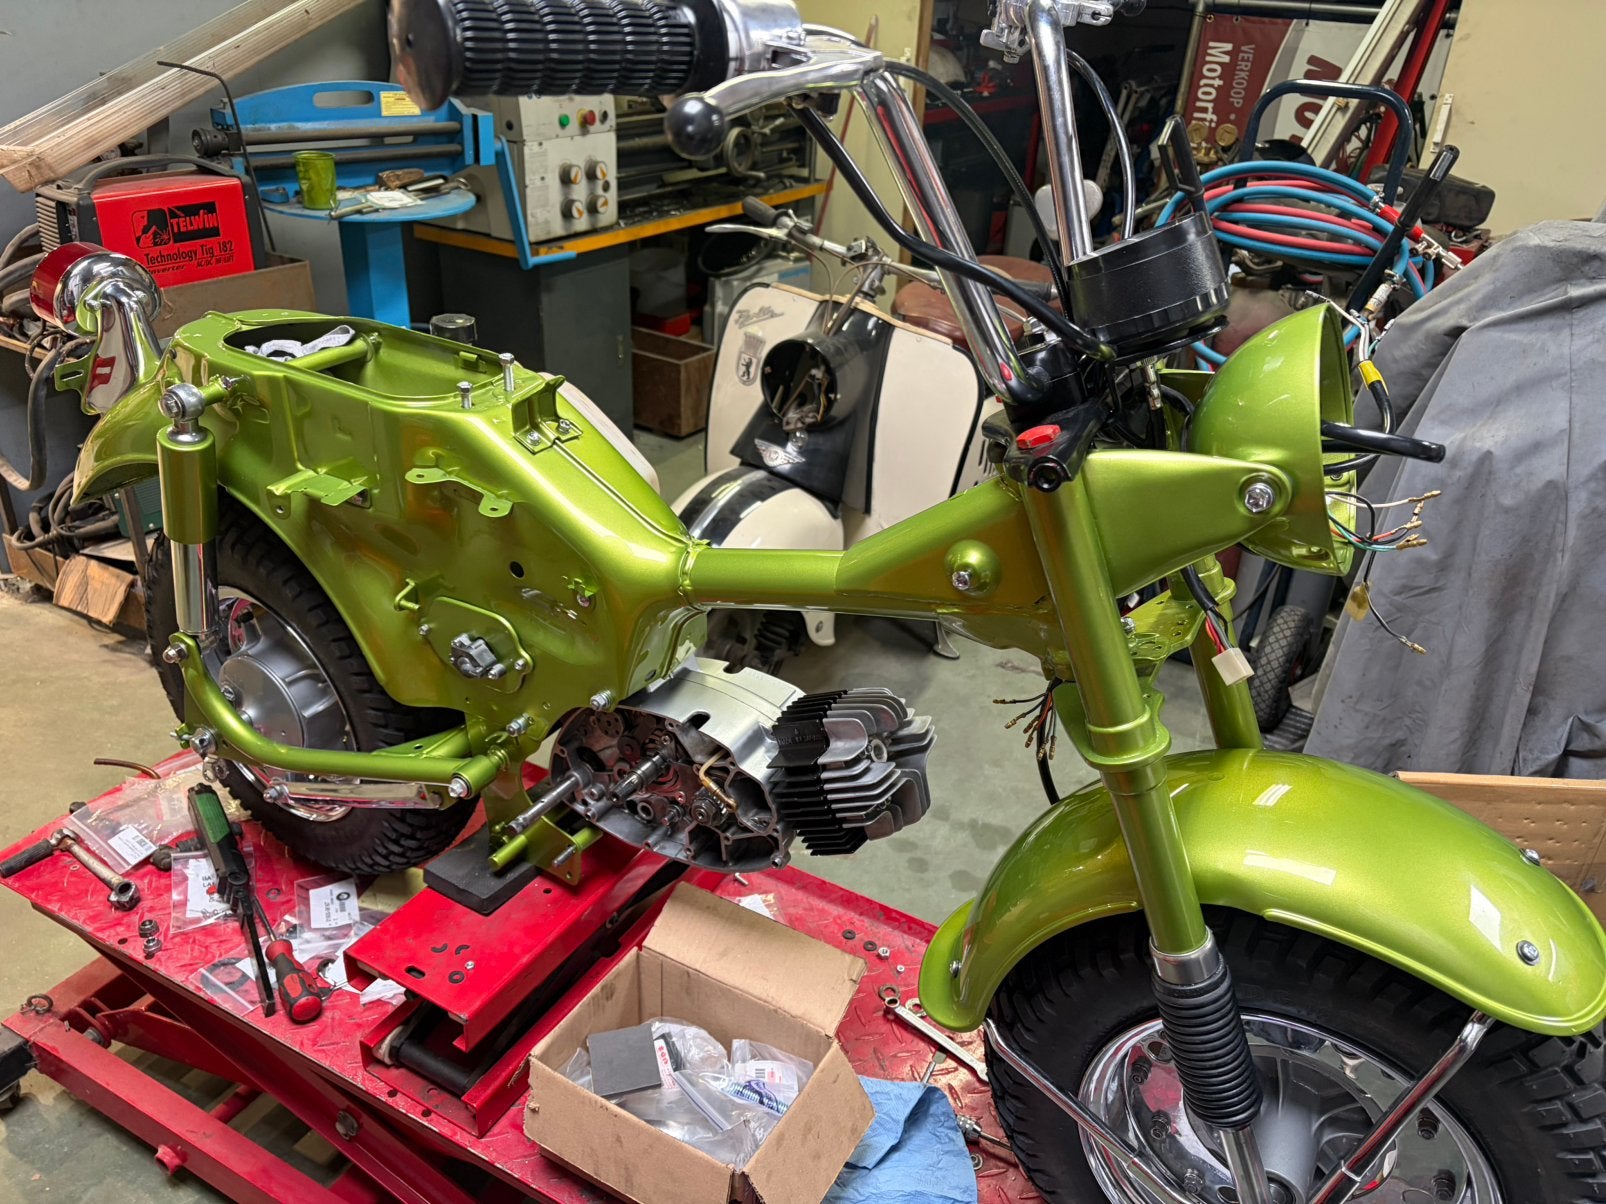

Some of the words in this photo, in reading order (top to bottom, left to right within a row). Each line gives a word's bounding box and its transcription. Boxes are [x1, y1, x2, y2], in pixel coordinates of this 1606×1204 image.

[1231, 44, 1255, 108] VERKOOP
[145, 249, 198, 265] Technology
[201, 244, 214, 257] Tig
[218, 240, 234, 254] 182
[148, 265, 185, 274] nverter
